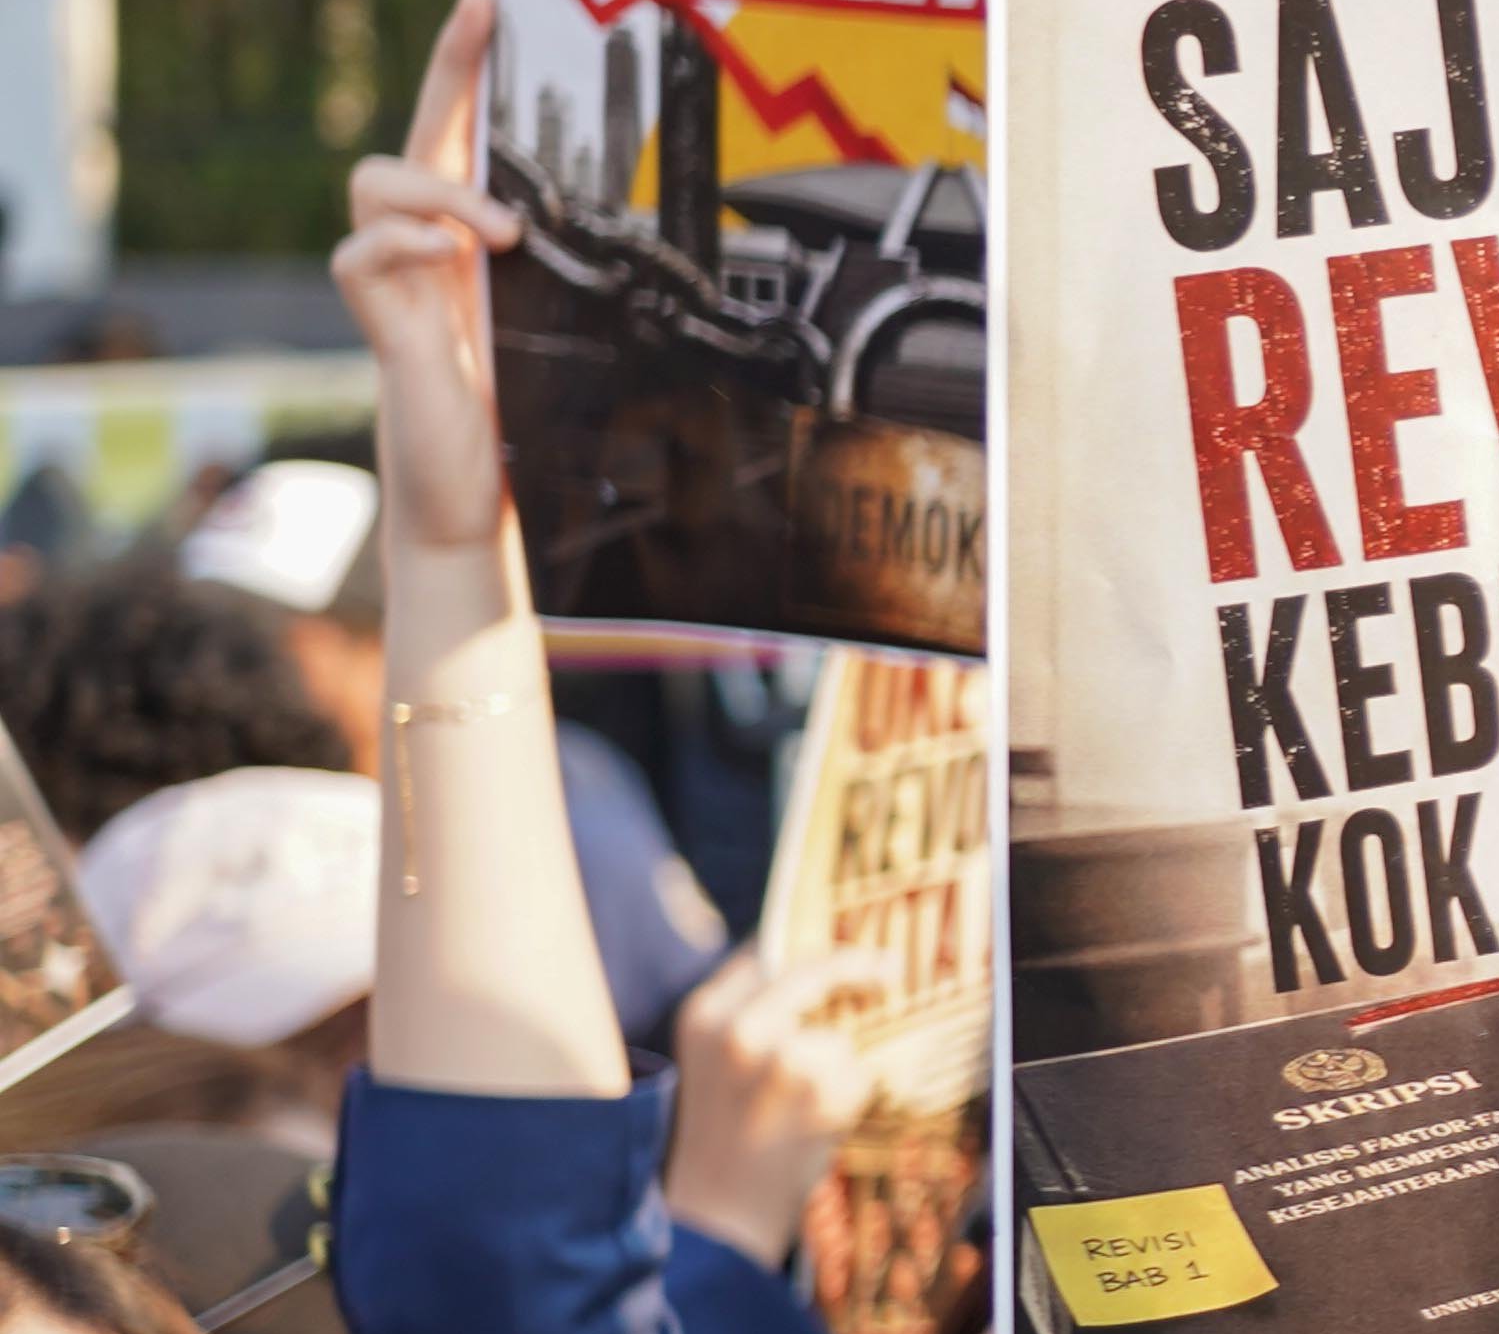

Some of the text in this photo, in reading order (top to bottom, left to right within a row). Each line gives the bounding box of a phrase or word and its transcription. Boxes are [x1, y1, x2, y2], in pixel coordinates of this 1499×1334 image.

[1272, 1070, 1483, 1132] SKRIPSI
[1233, 1143, 1361, 1186] ANALISIS
[1272, 1169, 1355, 1199] YANG
[1081, 1229, 1195, 1262] REVISI
[1095, 1258, 1209, 1294] BAB 1
